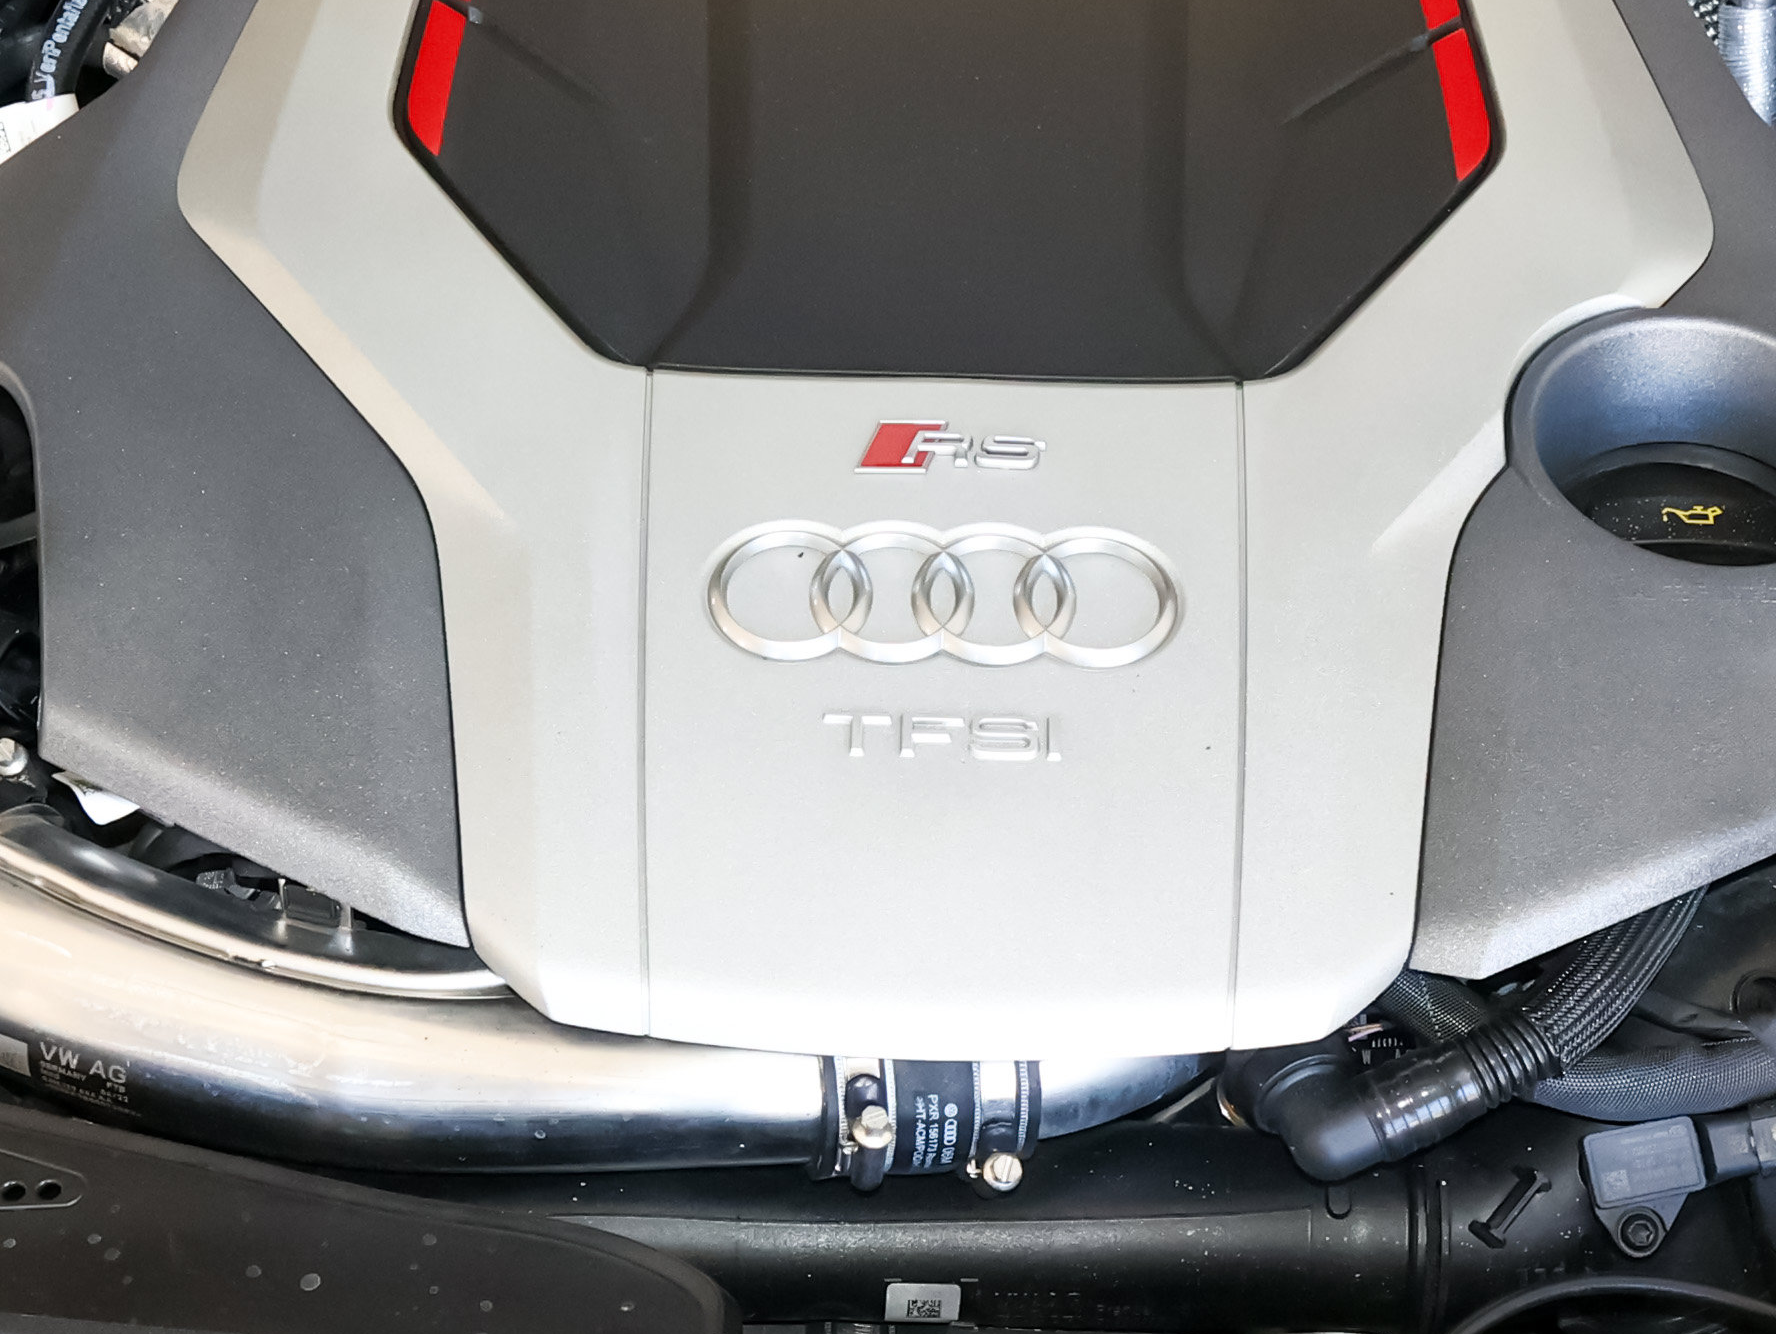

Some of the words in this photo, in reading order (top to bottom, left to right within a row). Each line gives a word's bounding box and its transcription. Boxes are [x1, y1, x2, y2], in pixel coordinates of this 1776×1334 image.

[900, 428, 1046, 471] RS
[821, 711, 1062, 762] TFSI
[40, 1041, 80, 1069] VW
[89, 1060, 126, 1083] AG
[928, 1094, 939, 1120] PXR
